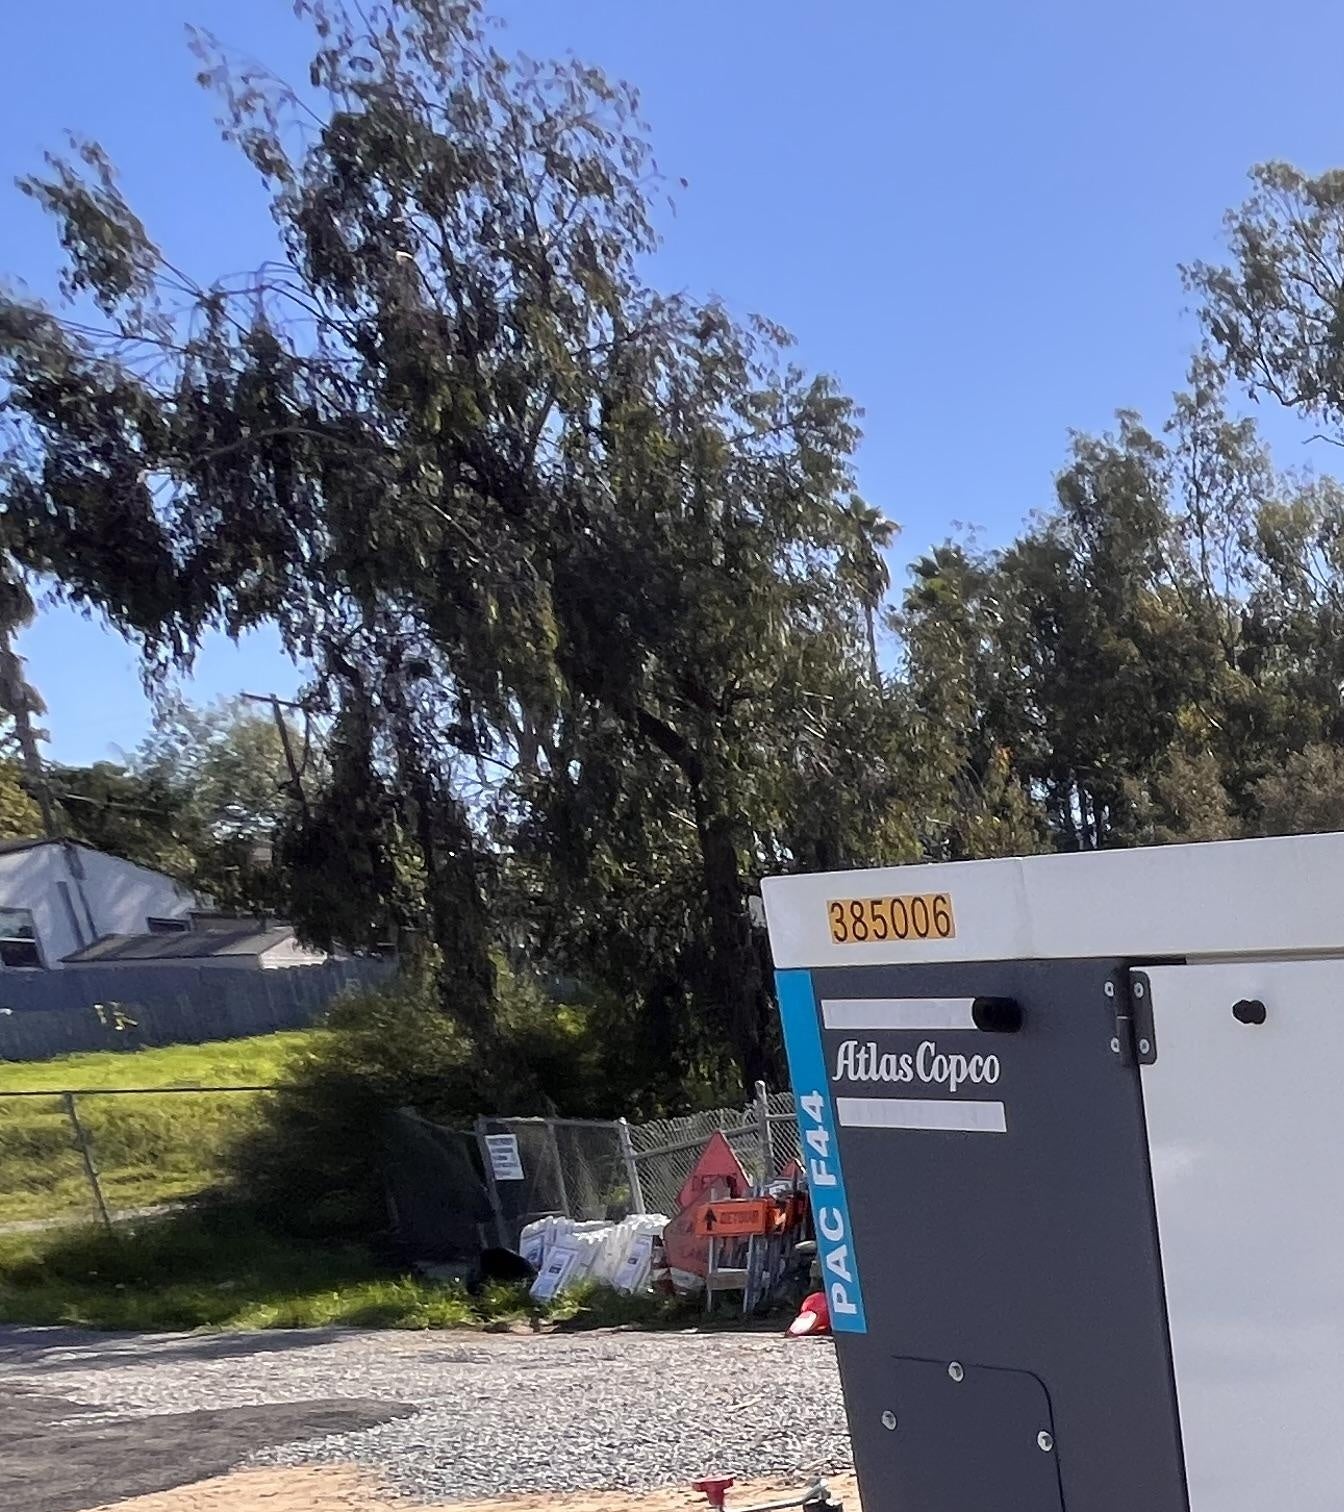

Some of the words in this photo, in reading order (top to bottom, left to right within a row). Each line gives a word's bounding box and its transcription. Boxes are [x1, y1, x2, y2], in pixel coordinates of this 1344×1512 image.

[830, 895, 951, 942] 385006
[801, 1090, 838, 1186] F44
[819, 1207, 857, 1315] PAC
